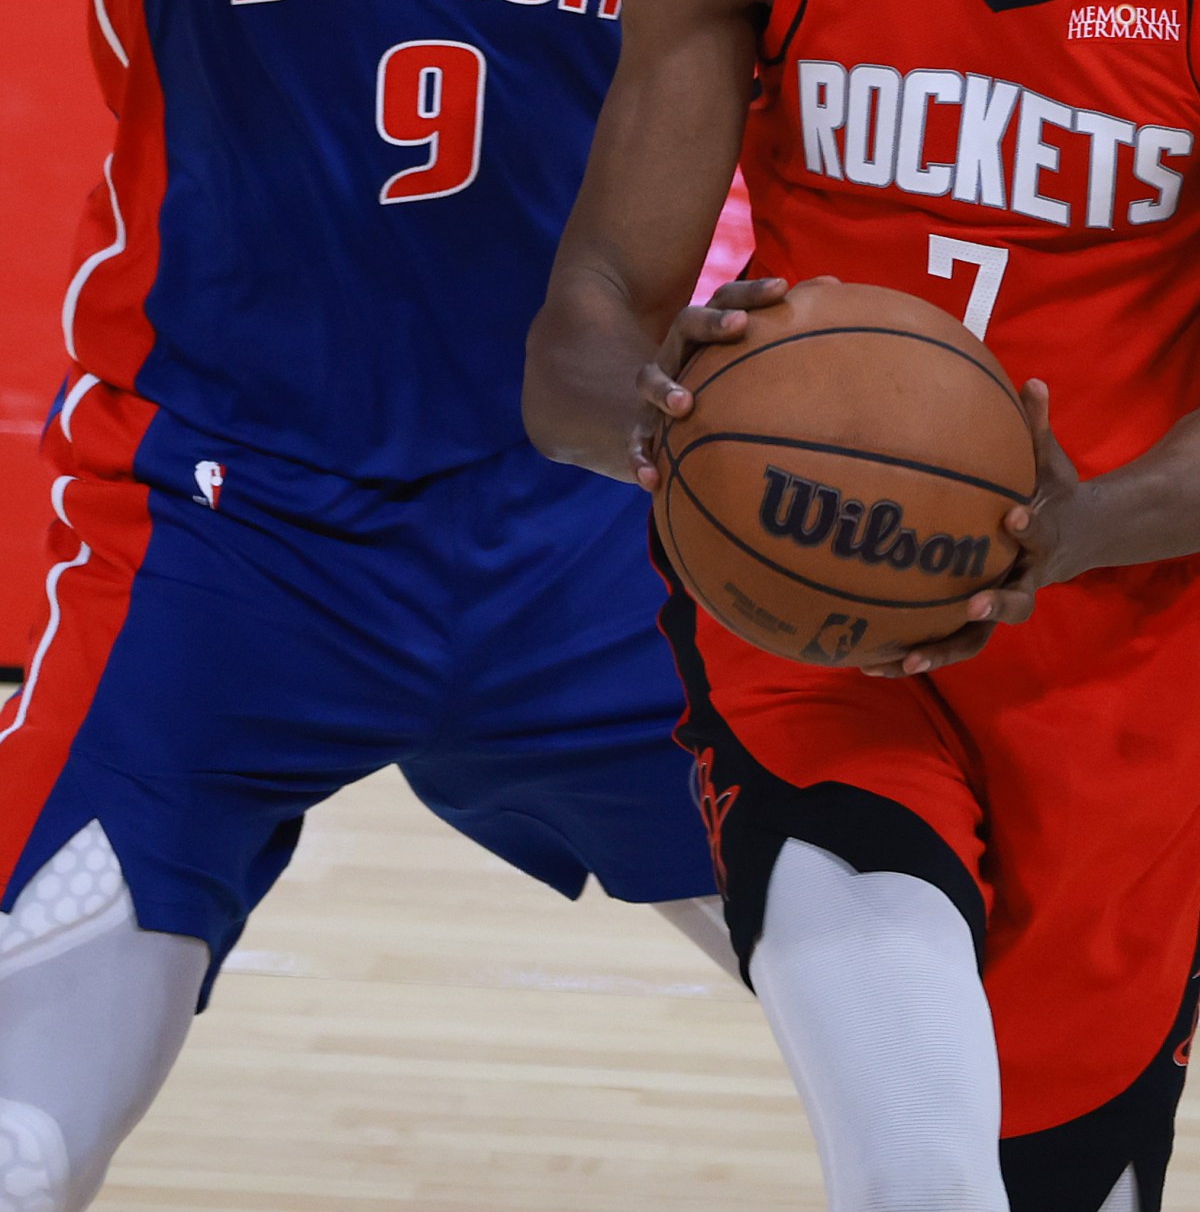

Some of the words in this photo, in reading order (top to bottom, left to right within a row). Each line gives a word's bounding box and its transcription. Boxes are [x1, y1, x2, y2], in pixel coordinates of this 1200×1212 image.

[1067, 21, 1180, 42] HERMANN
[1070, 4, 1180, 27] MEMORIAL
[376, 38, 487, 205] 9
[798, 59, 1195, 229] ROCKETS
[927, 233, 1010, 343] 7
[759, 464, 992, 578] Wilson
